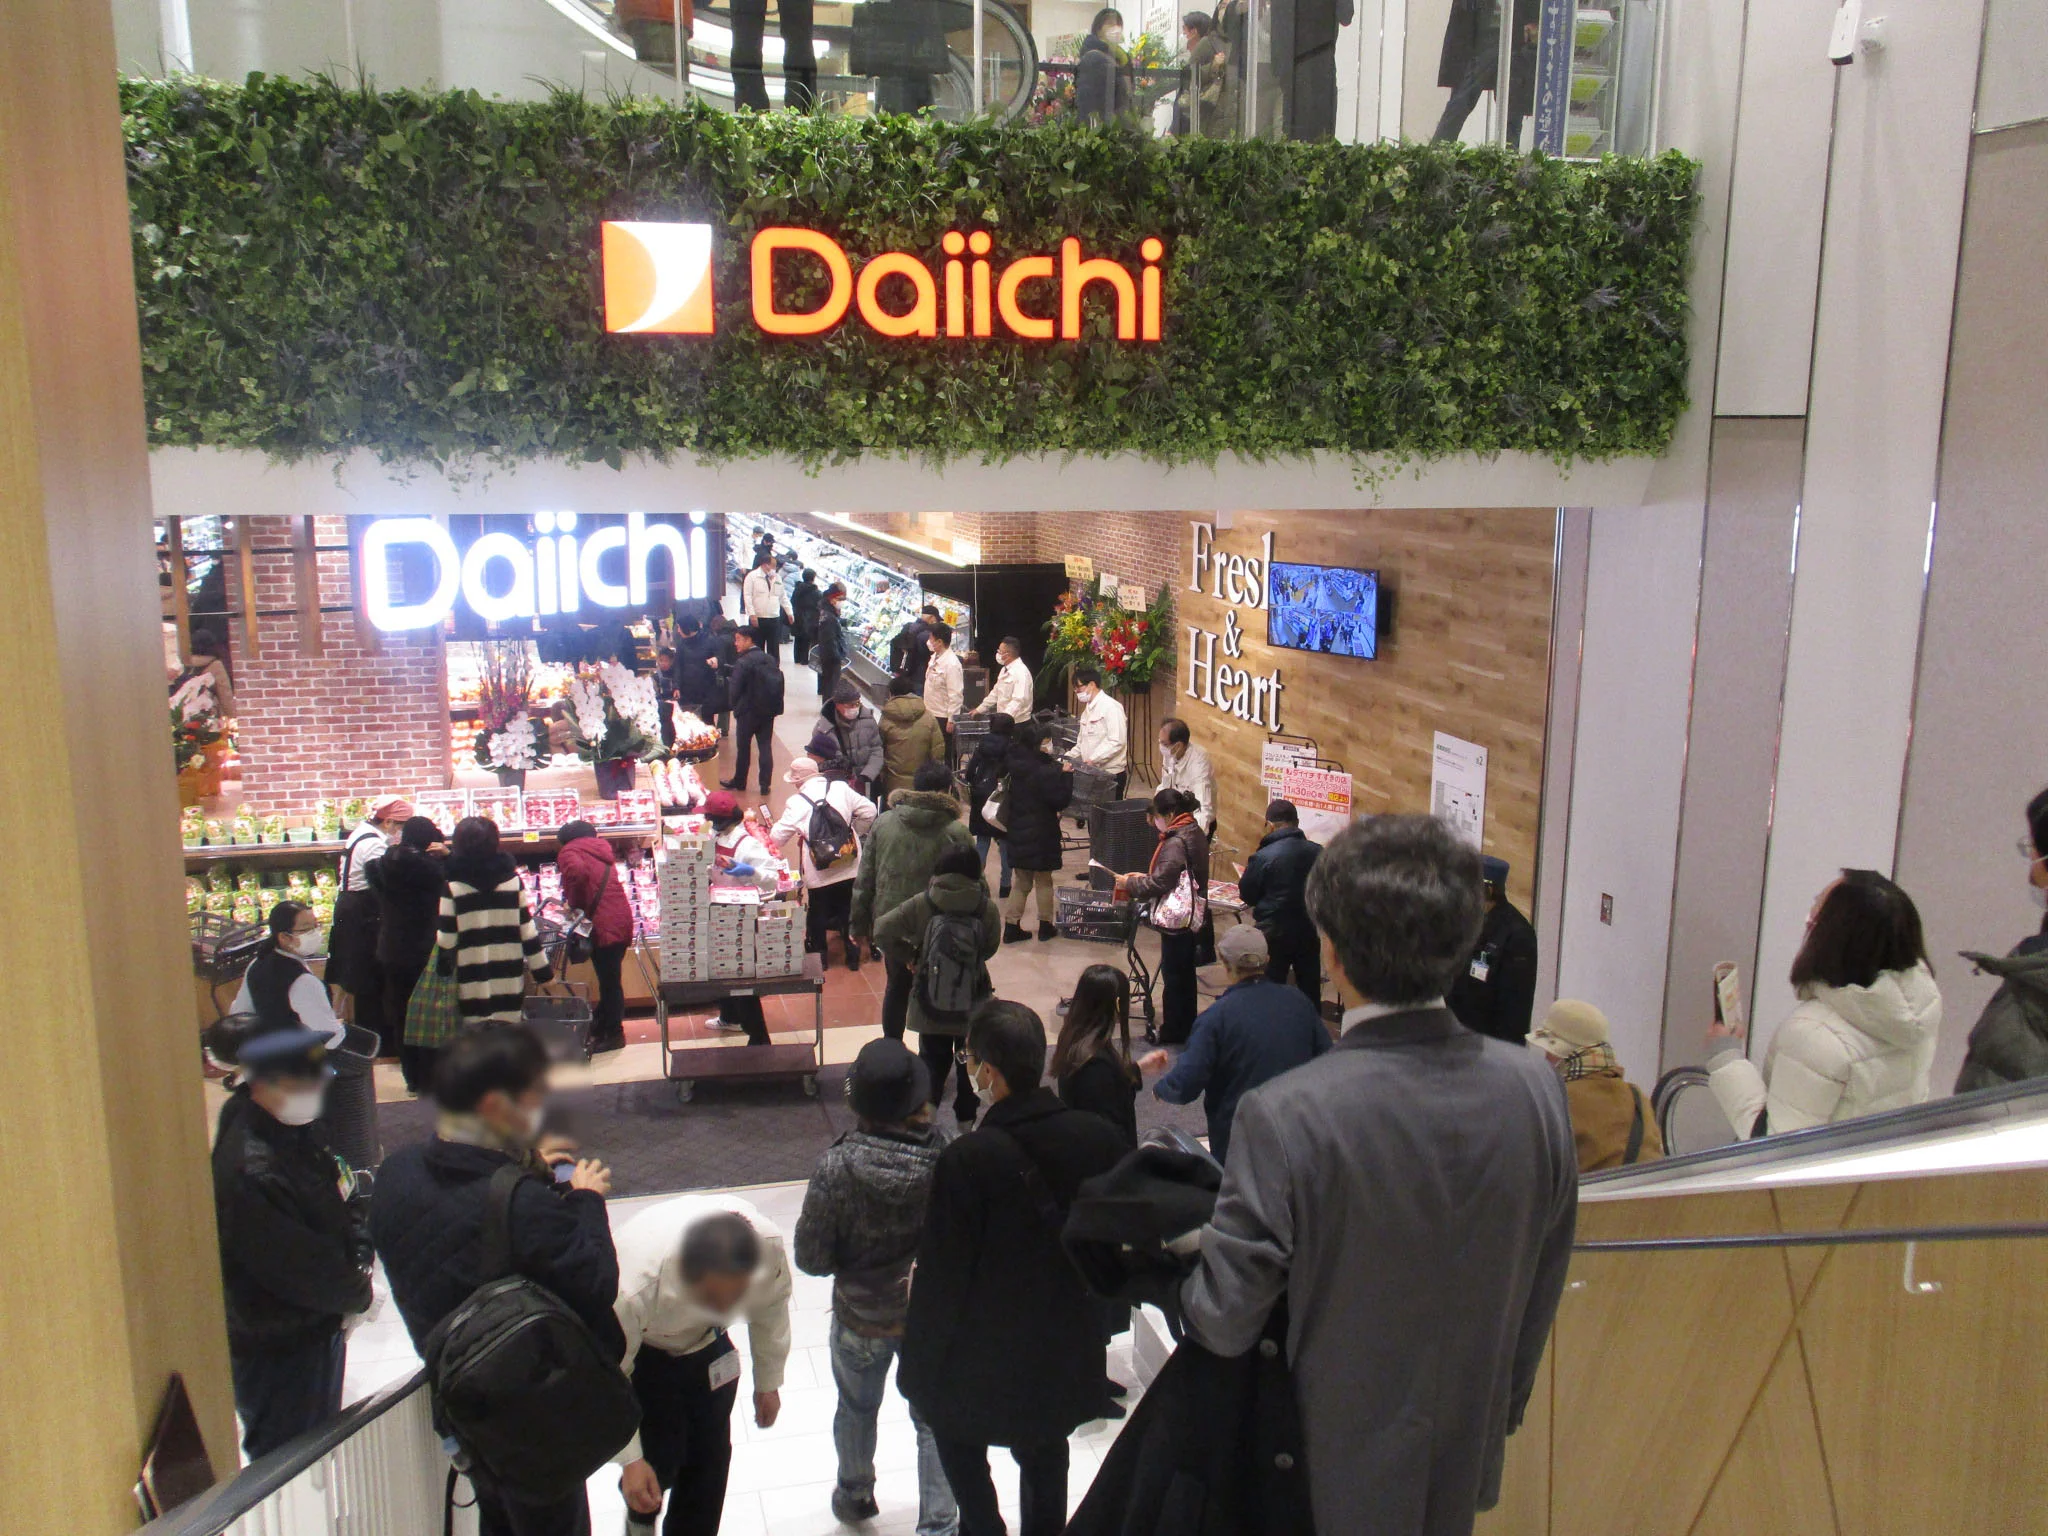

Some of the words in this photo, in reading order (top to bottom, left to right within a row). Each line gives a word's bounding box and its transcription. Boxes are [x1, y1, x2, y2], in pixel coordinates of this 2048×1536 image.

[750, 226, 1163, 341] Daiichi
[361, 510, 707, 632] Daiichi
[1185, 626, 1284, 733] Heart
[1222, 609, 1244, 659] &
